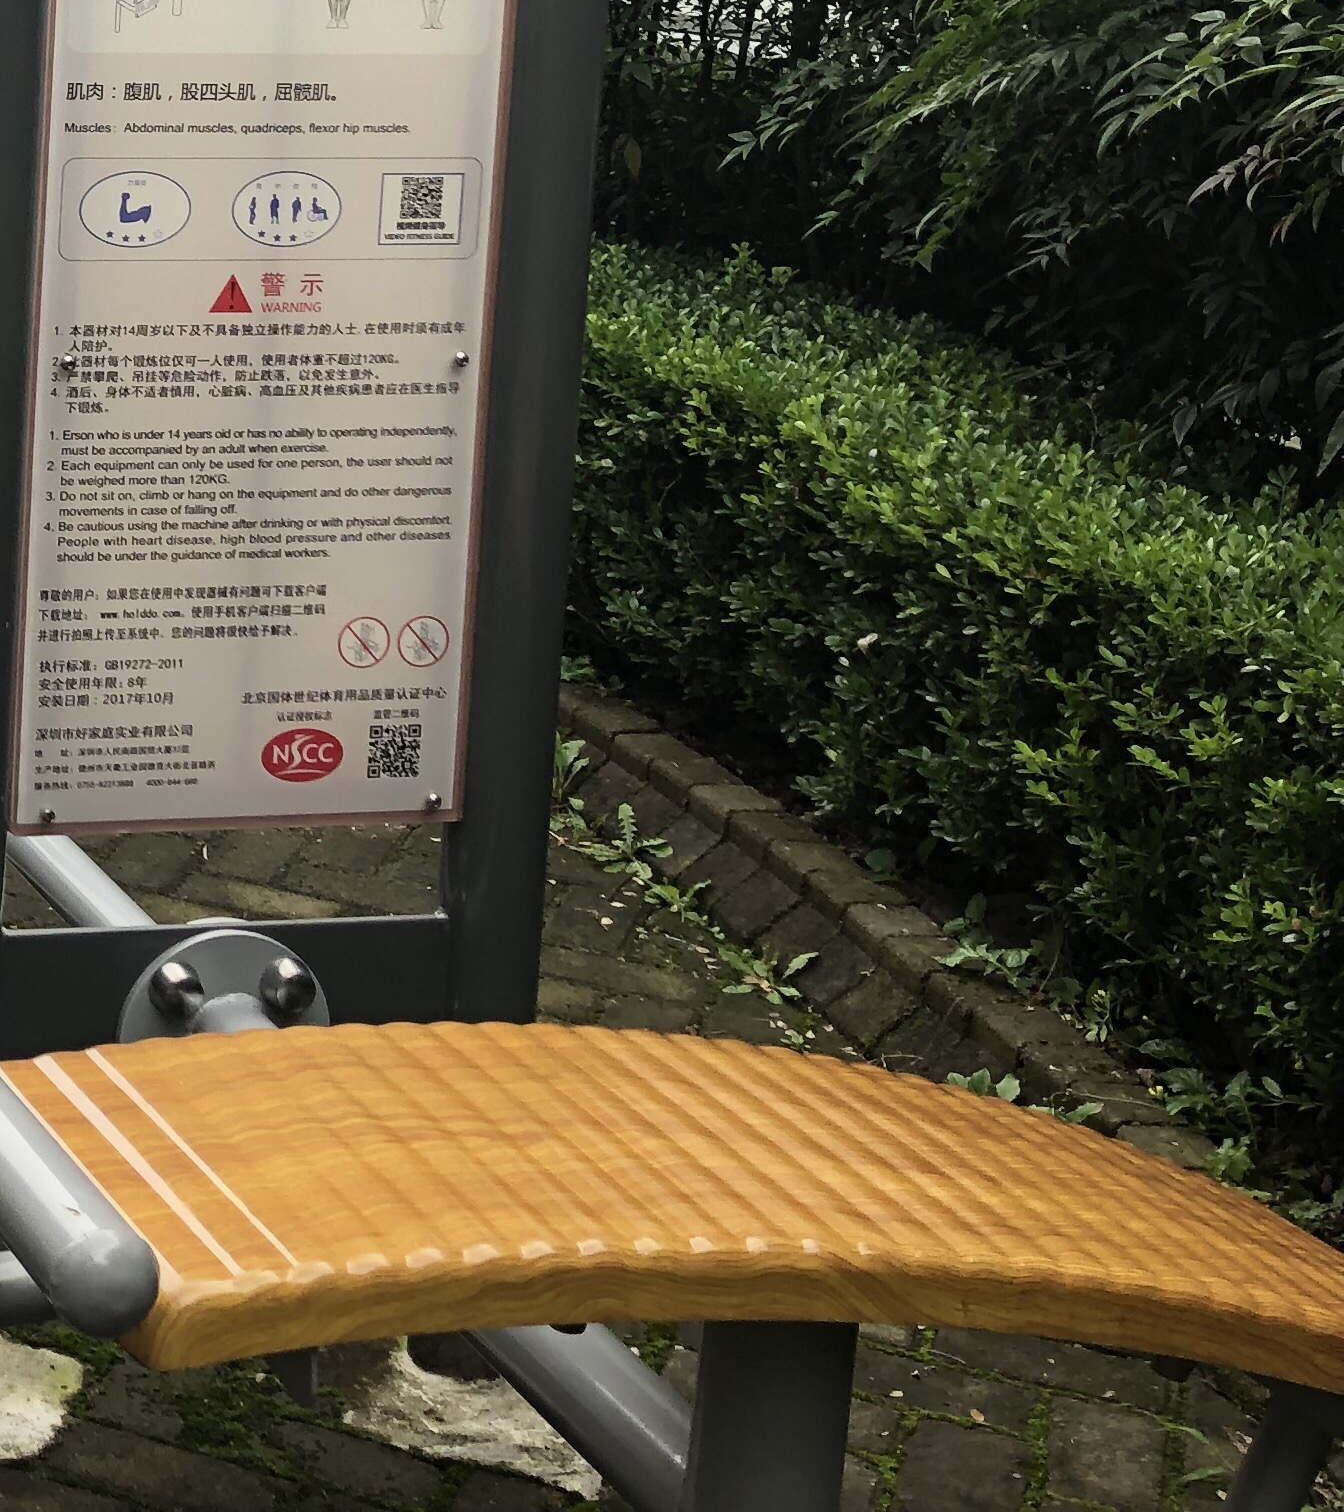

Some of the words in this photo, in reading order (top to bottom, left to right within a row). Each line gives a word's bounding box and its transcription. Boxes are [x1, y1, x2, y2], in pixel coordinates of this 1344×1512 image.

[122, 122, 185, 134] Abdominal
[308, 122, 341, 134] flexor
[342, 122, 360, 136] hip
[260, 301, 322, 313] WARNING
[67, 339, 113, 353] 人陪护。
[64, 401, 110, 414] 下锻炼。
[62, 430, 95, 441] Erson
[96, 429, 120, 440] who
[132, 429, 166, 440] under
[182, 430, 213, 442] years
[246, 427, 267, 439] has
[60, 445, 89, 456] must
[107, 443, 183, 458] accompanied
[217, 443, 246, 455] adult
[247, 442, 279, 454] when
[60, 459, 91, 471] Each
[93, 459, 155, 474] equipment
[157, 460, 179, 470] can
[181, 458, 206, 472] only
[226, 457, 255, 470] used
[256, 457, 274, 469] for
[275, 459, 298, 469] one
[345, 456, 365, 468] the
[366, 457, 393, 467] user
[393, 454, 432, 467] should
[434, 455, 454, 466] not
[77, 474, 126, 489] weighed
[127, 476, 158, 486] more
[159, 474, 185, 485] than
[58, 490, 77, 502] Do
[78, 490, 98, 502] not
[138, 488, 170, 501] climb
[186, 488, 217, 502] hang
[236, 487, 255, 499] the
[256, 487, 318, 501] equipment
[319, 486, 342, 498] and
[360, 486, 391, 497] other
[392, 485, 453, 499] dangerous
[58, 505, 125, 517] movements
[139, 506, 168, 516] case
[57, 520, 74, 532] Be
[75, 520, 125, 532] cautious
[126, 520, 158, 533] using
[160, 519, 179, 531] the
[180, 518, 230, 530] machine
[231, 517, 259, 530] after
[56, 535, 100, 549] People
[130, 534, 163, 546] heart
[219, 533, 246, 547] high
[248, 532, 282, 544] blood
[284, 533, 338, 546] pressure
[339, 530, 363, 543] and
[365, 531, 397, 542] other
[398, 529, 452, 541] diseases
[55, 550, 95, 563] should
[96, 550, 113, 562] be
[113, 550, 149, 562] under
[149, 550, 169, 561] the
[170, 548, 223, 563] guidance
[237, 547, 282, 560] medical
[372, 708, 420, 720] 监管二维码
[34, 723, 193, 742] 深圳市好家庭实业有限公司
[272, 734, 335, 769] NSCC
